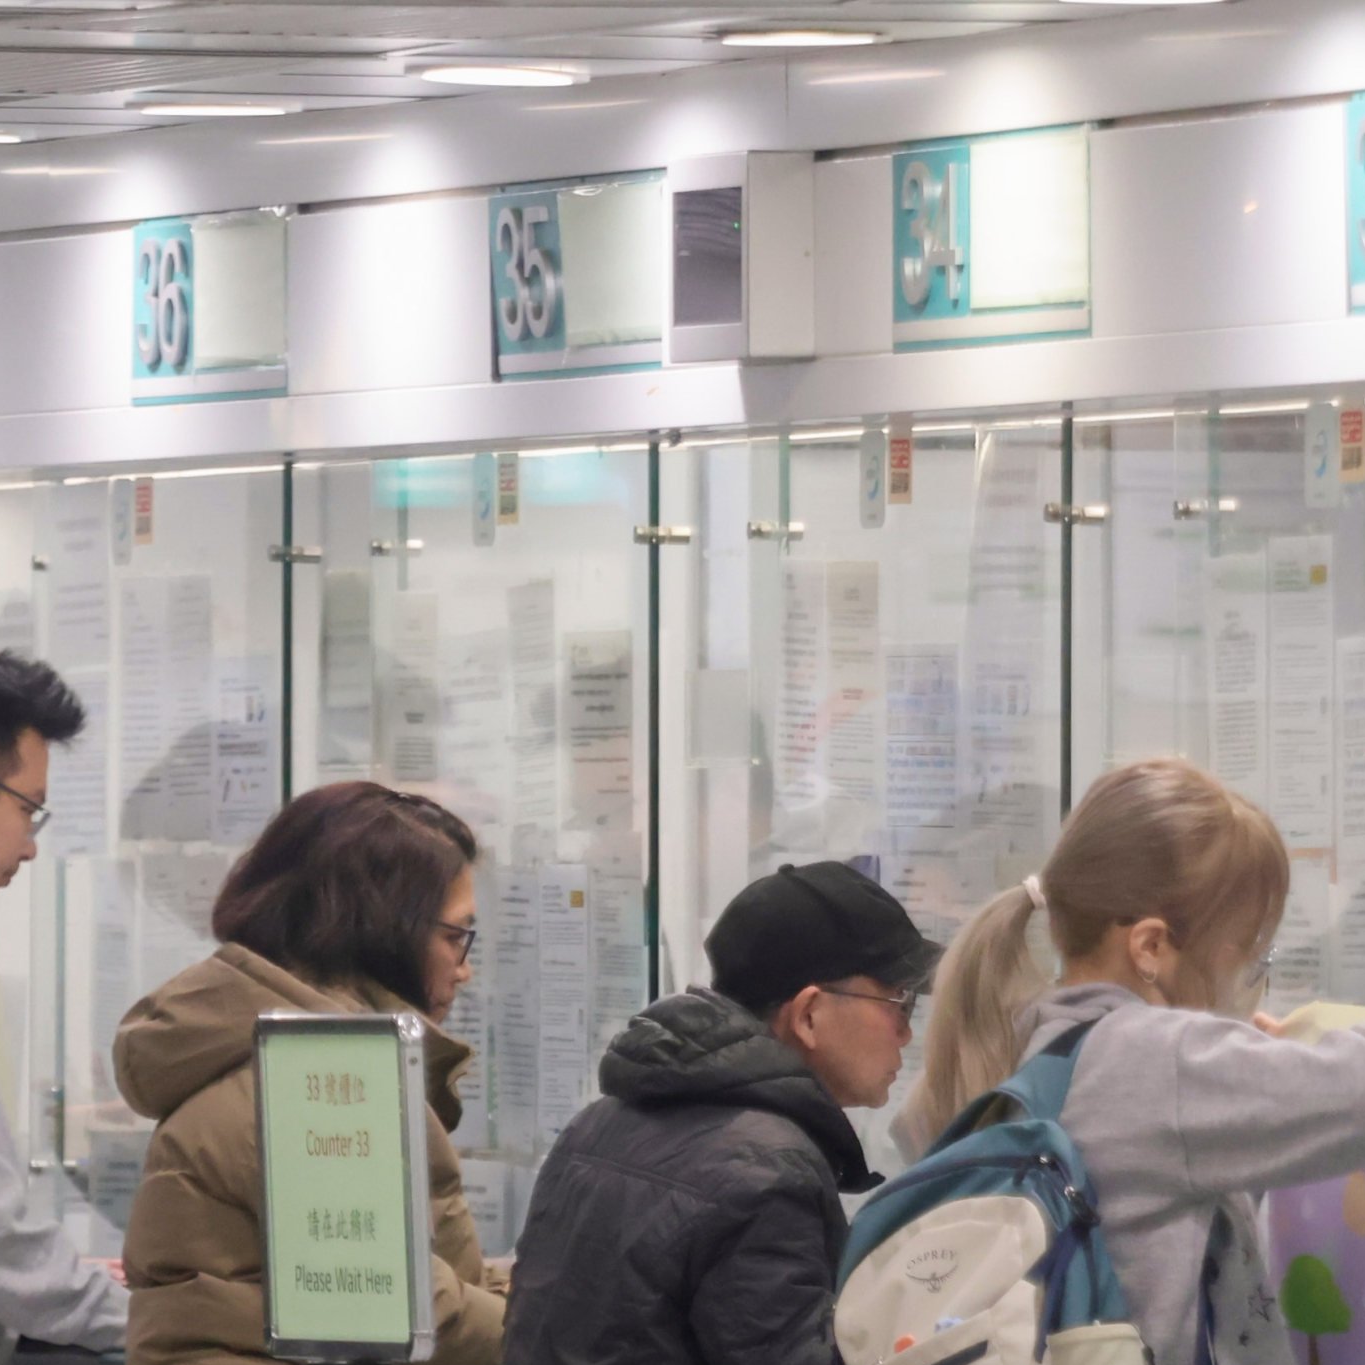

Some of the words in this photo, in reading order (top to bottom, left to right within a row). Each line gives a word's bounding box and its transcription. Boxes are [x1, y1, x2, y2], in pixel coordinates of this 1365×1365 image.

[901, 161, 962, 305] 34
[496, 206, 554, 341] 35
[138, 238, 186, 367] 36
[305, 1129, 353, 1158] Counter
[356, 1130, 371, 1158] 33
[306, 1207, 377, 1242] 請在此稍候
[906, 1249, 958, 1270] OSPREY
[294, 1263, 333, 1294] Please
[334, 1266, 363, 1294] Wait
[364, 1267, 393, 1296] Here
